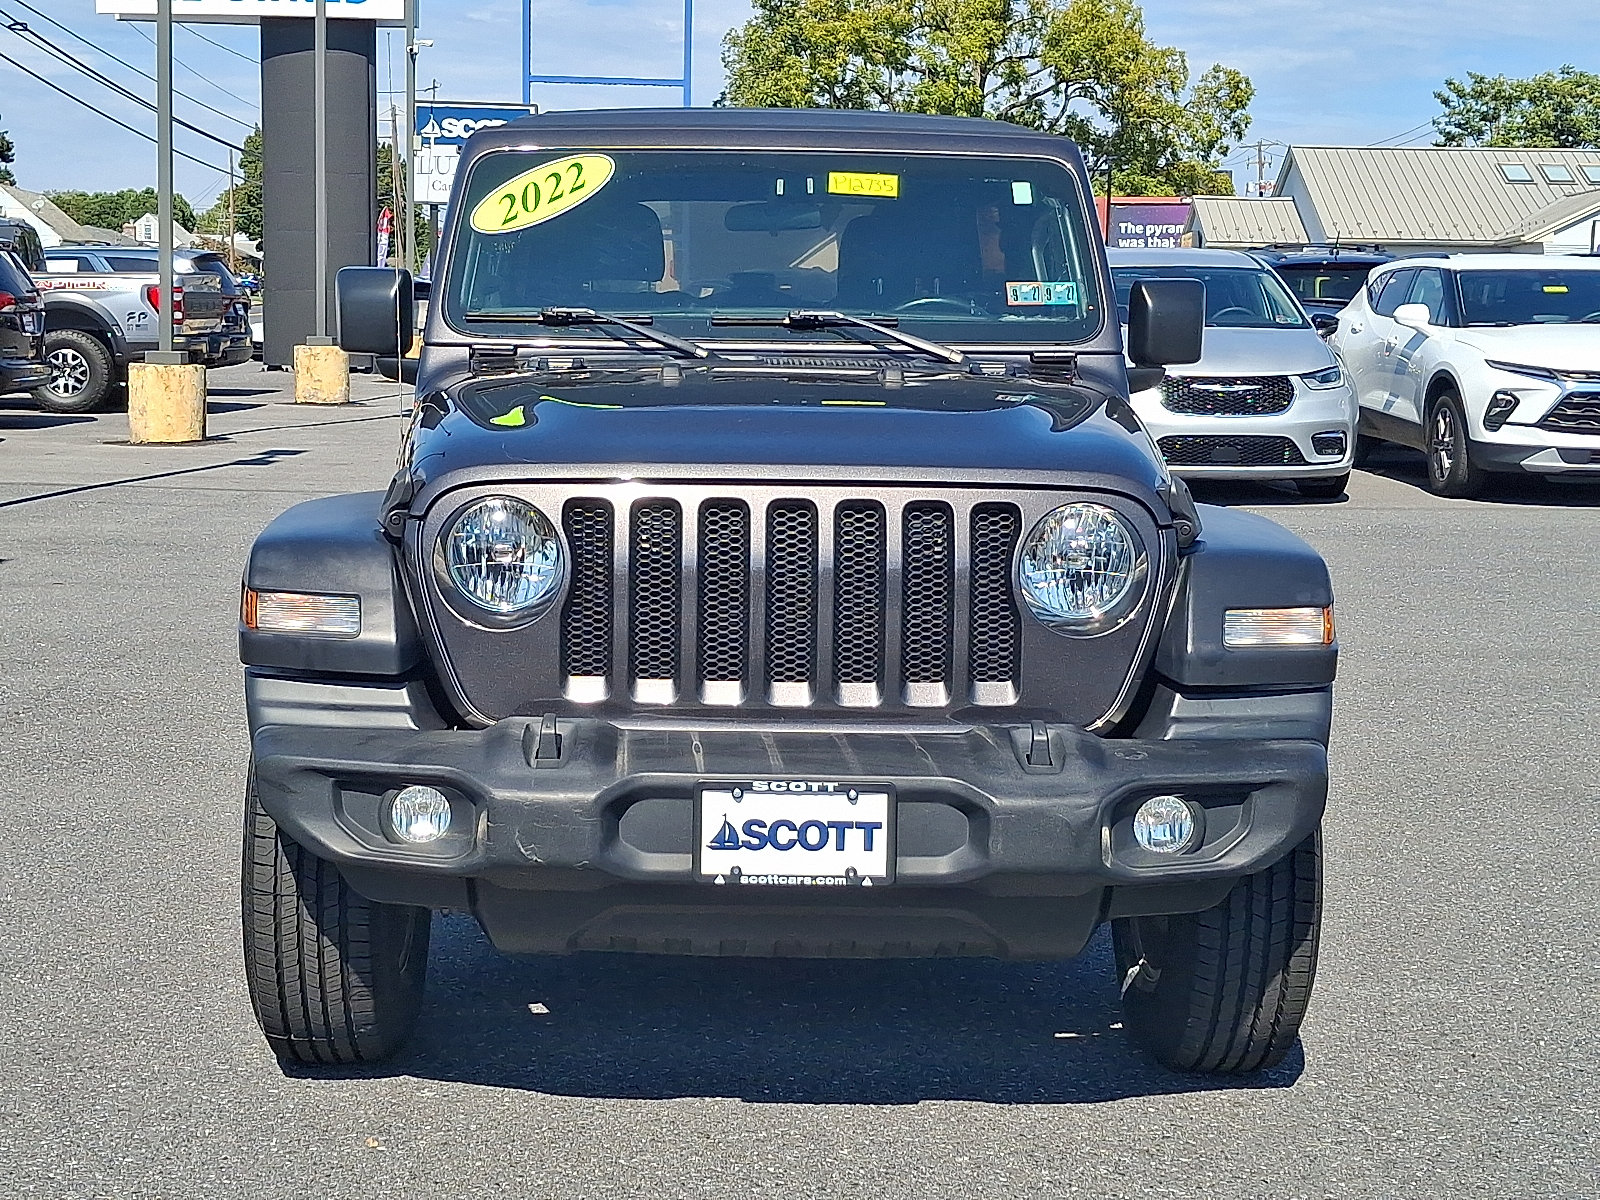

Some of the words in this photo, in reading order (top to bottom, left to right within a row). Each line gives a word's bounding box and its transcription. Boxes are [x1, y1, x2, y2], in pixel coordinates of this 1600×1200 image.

[498, 162, 586, 227] 2022
[1118, 222, 1144, 234] The
[1118, 238, 1145, 248] was
[1147, 236, 1175, 248] that
[751, 780, 840, 793] SCOTT
[741, 818, 882, 852] SCOTT
[739, 874, 847, 886] scottcars.com
